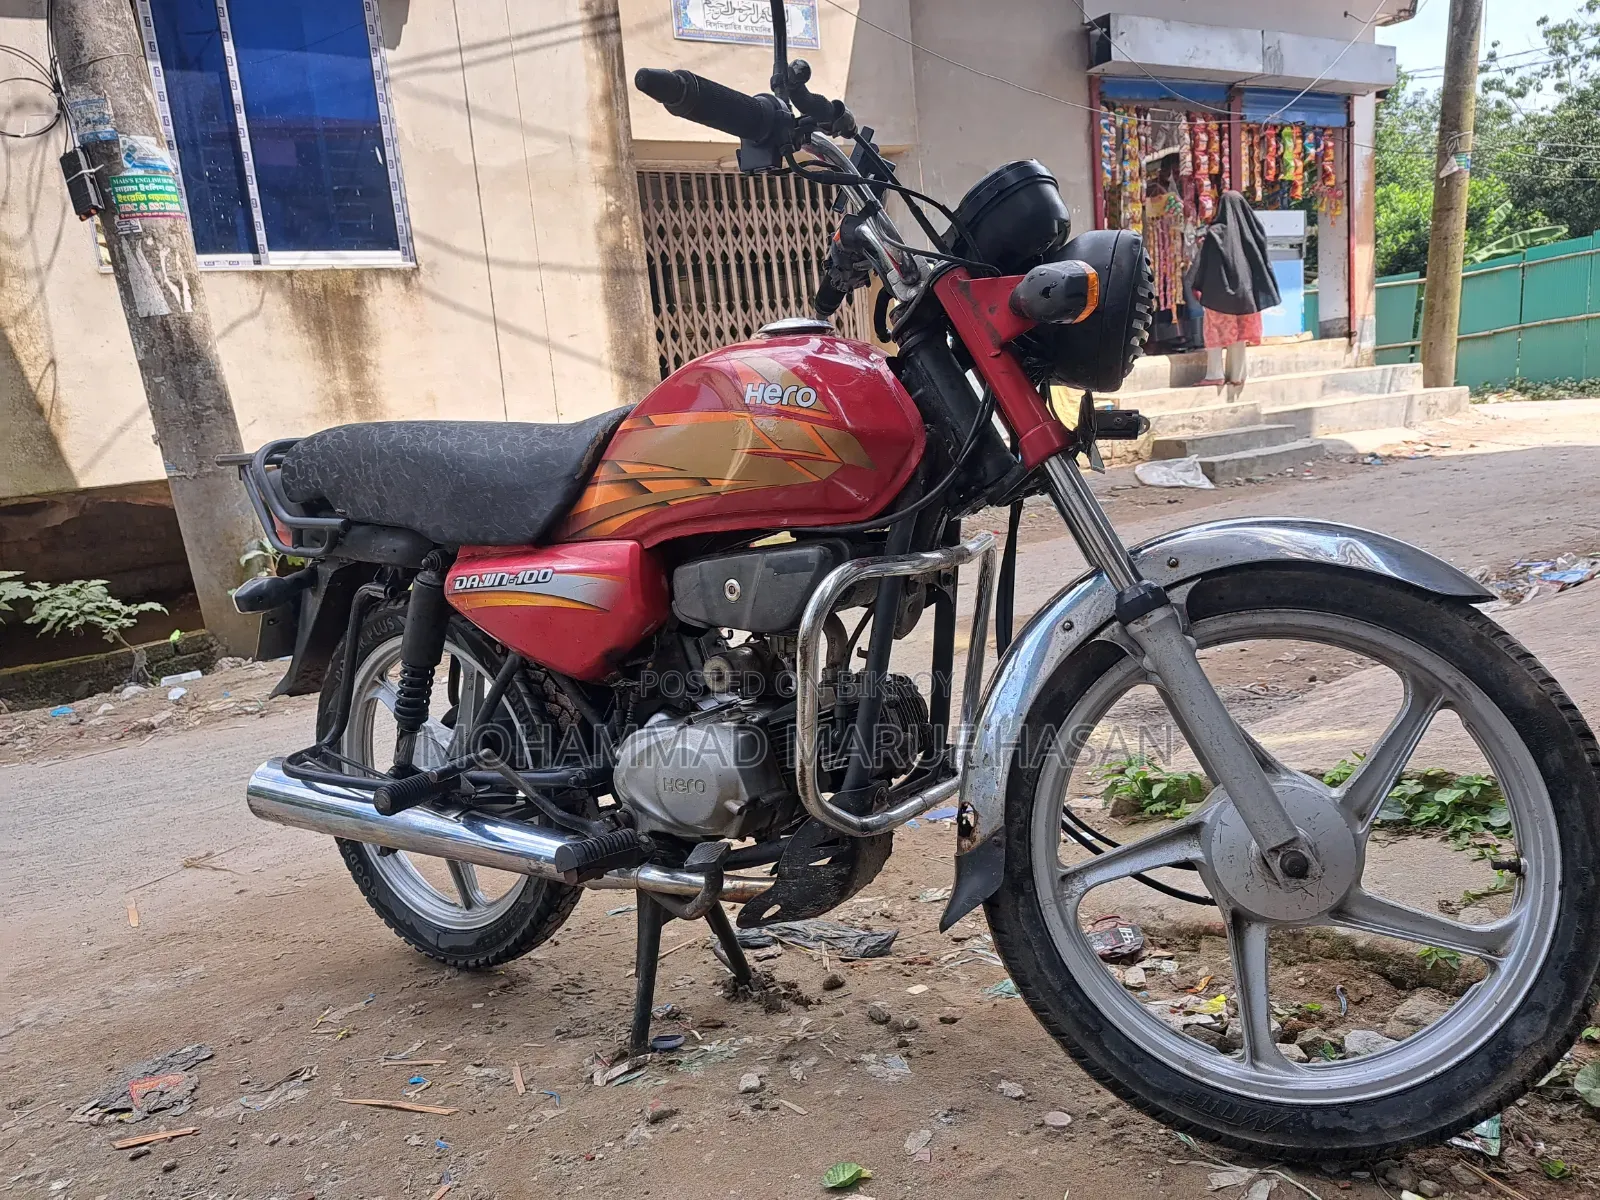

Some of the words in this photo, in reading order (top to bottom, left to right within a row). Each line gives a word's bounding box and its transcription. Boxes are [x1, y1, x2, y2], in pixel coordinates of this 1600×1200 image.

[744, 382, 817, 408] Hero
[453, 568, 555, 590] DAWN-100
[662, 777, 706, 795] Hero
